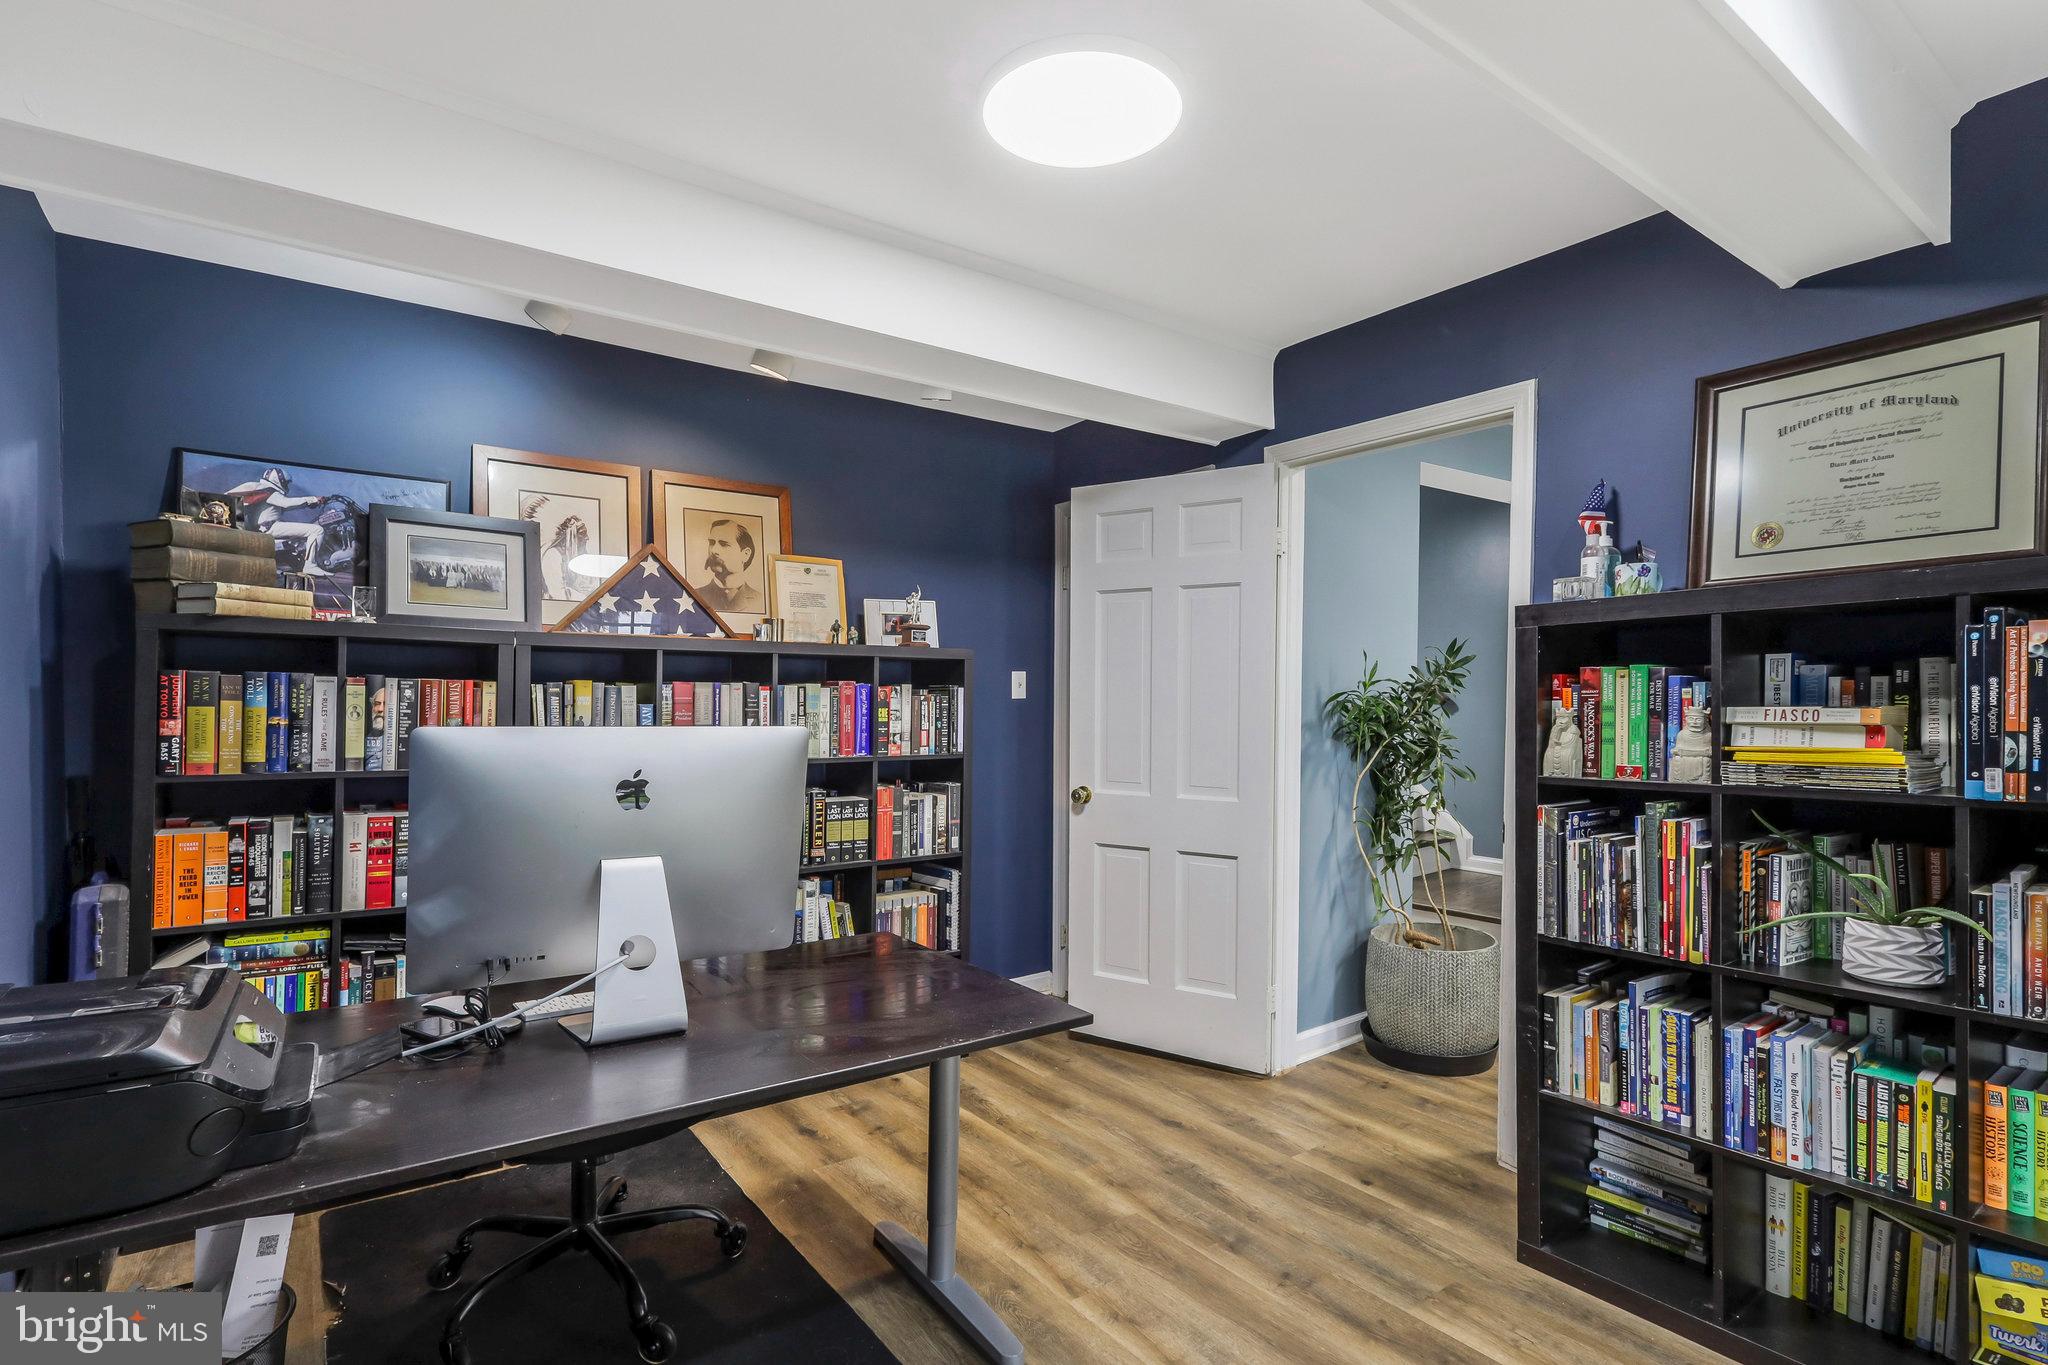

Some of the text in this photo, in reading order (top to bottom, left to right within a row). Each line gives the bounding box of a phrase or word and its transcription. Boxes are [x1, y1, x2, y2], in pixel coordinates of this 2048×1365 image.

[1777, 394, 1960, 439] University of Maryland
[1850, 458, 1868, 466] Marie
[1870, 454, 1895, 462] Adams
[2008, 629, 2017, 639] Art
[2008, 646, 2017, 670] Problem
[193, 679, 201, 701] TOLL
[247, 679, 255, 700] TOLL
[256, 677, 264, 692] IAN
[2008, 671, 2017, 691] Solving
[161, 675, 170, 718] AT TOKYO
[172, 675, 181, 718] JUDGMENT
[449, 683, 461, 714] STANTON
[1928, 672, 1941, 716] THE RUSSIAN
[1988, 677, 1999, 733] enVision Algebra
[2008, 692, 2017, 715] Volume
[1764, 708, 1820, 722] FIASCO
[1970, 685, 1980, 741] enVision Algebra
[161, 742, 169, 761] BASS
[172, 738, 180, 758] GARY
[815, 802, 823, 846] HITLER
[322, 835, 330, 858] FINAL
[156, 866, 164, 918] THIRD REICH
[1816, 884, 1824, 899] DIET
[1648, 906, 1657, 940] HISTORY
[1995, 899, 2008, 994] BASIC FISHING
[1978, 965, 1986, 988] Before
[1621, 1005, 1629, 1025] TOTAL
[1876, 1018, 1886, 1051] HOME
[1774, 1041, 1782, 1126] DAVE ASPREY FAST THIS WAY
[1790, 1072, 1799, 1087] Your
[1667, 1089, 1677, 1104] CODE
[1790, 1089, 1799, 1109] Blood
[1877, 1083, 1889, 1117] LOST CITY
[1940, 1096, 1948, 1114] COLLINS
[1790, 1111, 1799, 1131] Never
[1857, 1105, 1867, 1120] LAST
[1790, 1133, 1799, 1147] Lies
[1986, 1116, 1997, 1162] HISTORY
[1998, 1118, 2006, 1164] AMERICAN
[2013, 1122, 2028, 1172] SCIENCE
[2037, 1130, 2046, 1170] HISTORY
[1944, 1142, 1952, 1167] BALLAD
[1769, 1185, 1777, 1210] BODY
[1838, 1224, 1846, 1244] Gulp.
[1769, 1239, 1777, 1273] BRYSON
[1778, 1249, 1786, 1268] BILL
[1990, 1324, 2044, 1352] Twerk
